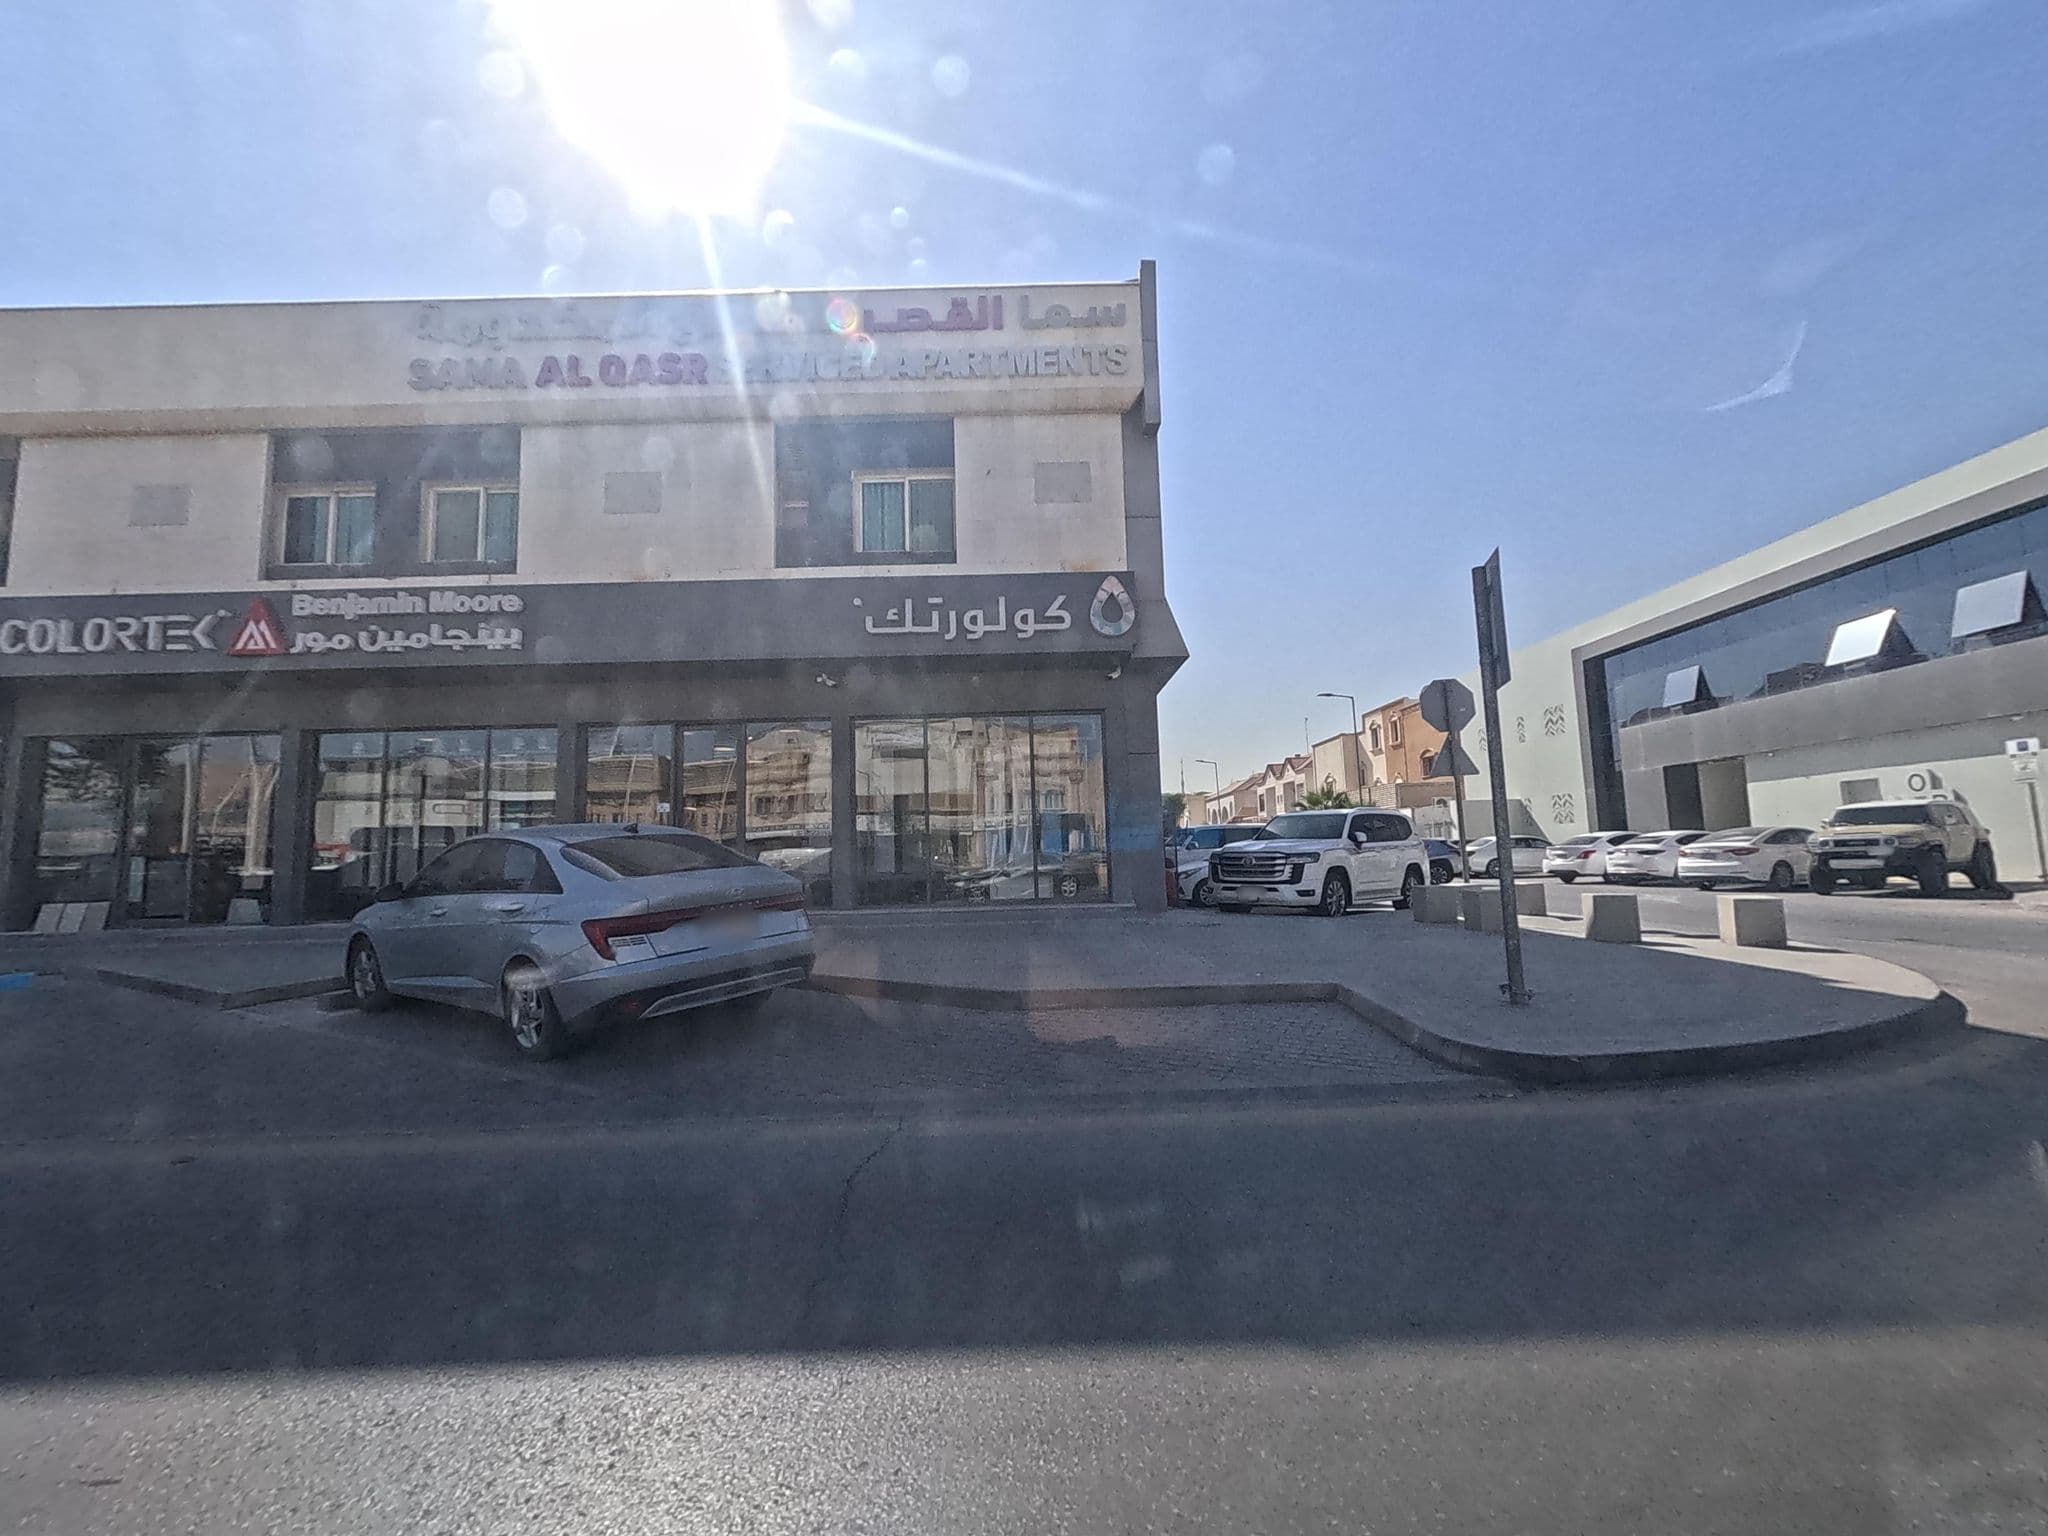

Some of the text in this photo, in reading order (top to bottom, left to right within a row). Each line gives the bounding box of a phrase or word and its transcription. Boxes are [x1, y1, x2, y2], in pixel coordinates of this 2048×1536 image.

[1019, 294, 1126, 331] سما
[535, 354, 592, 388] AL
[889, 344, 1127, 380] APARTMENTS
[291, 590, 523, 620] Benjamin Moore
[864, 594, 1072, 640] كولورتك
[0, 614, 218, 653] COLORTEK
[290, 622, 523, 655] بينجامين مور
